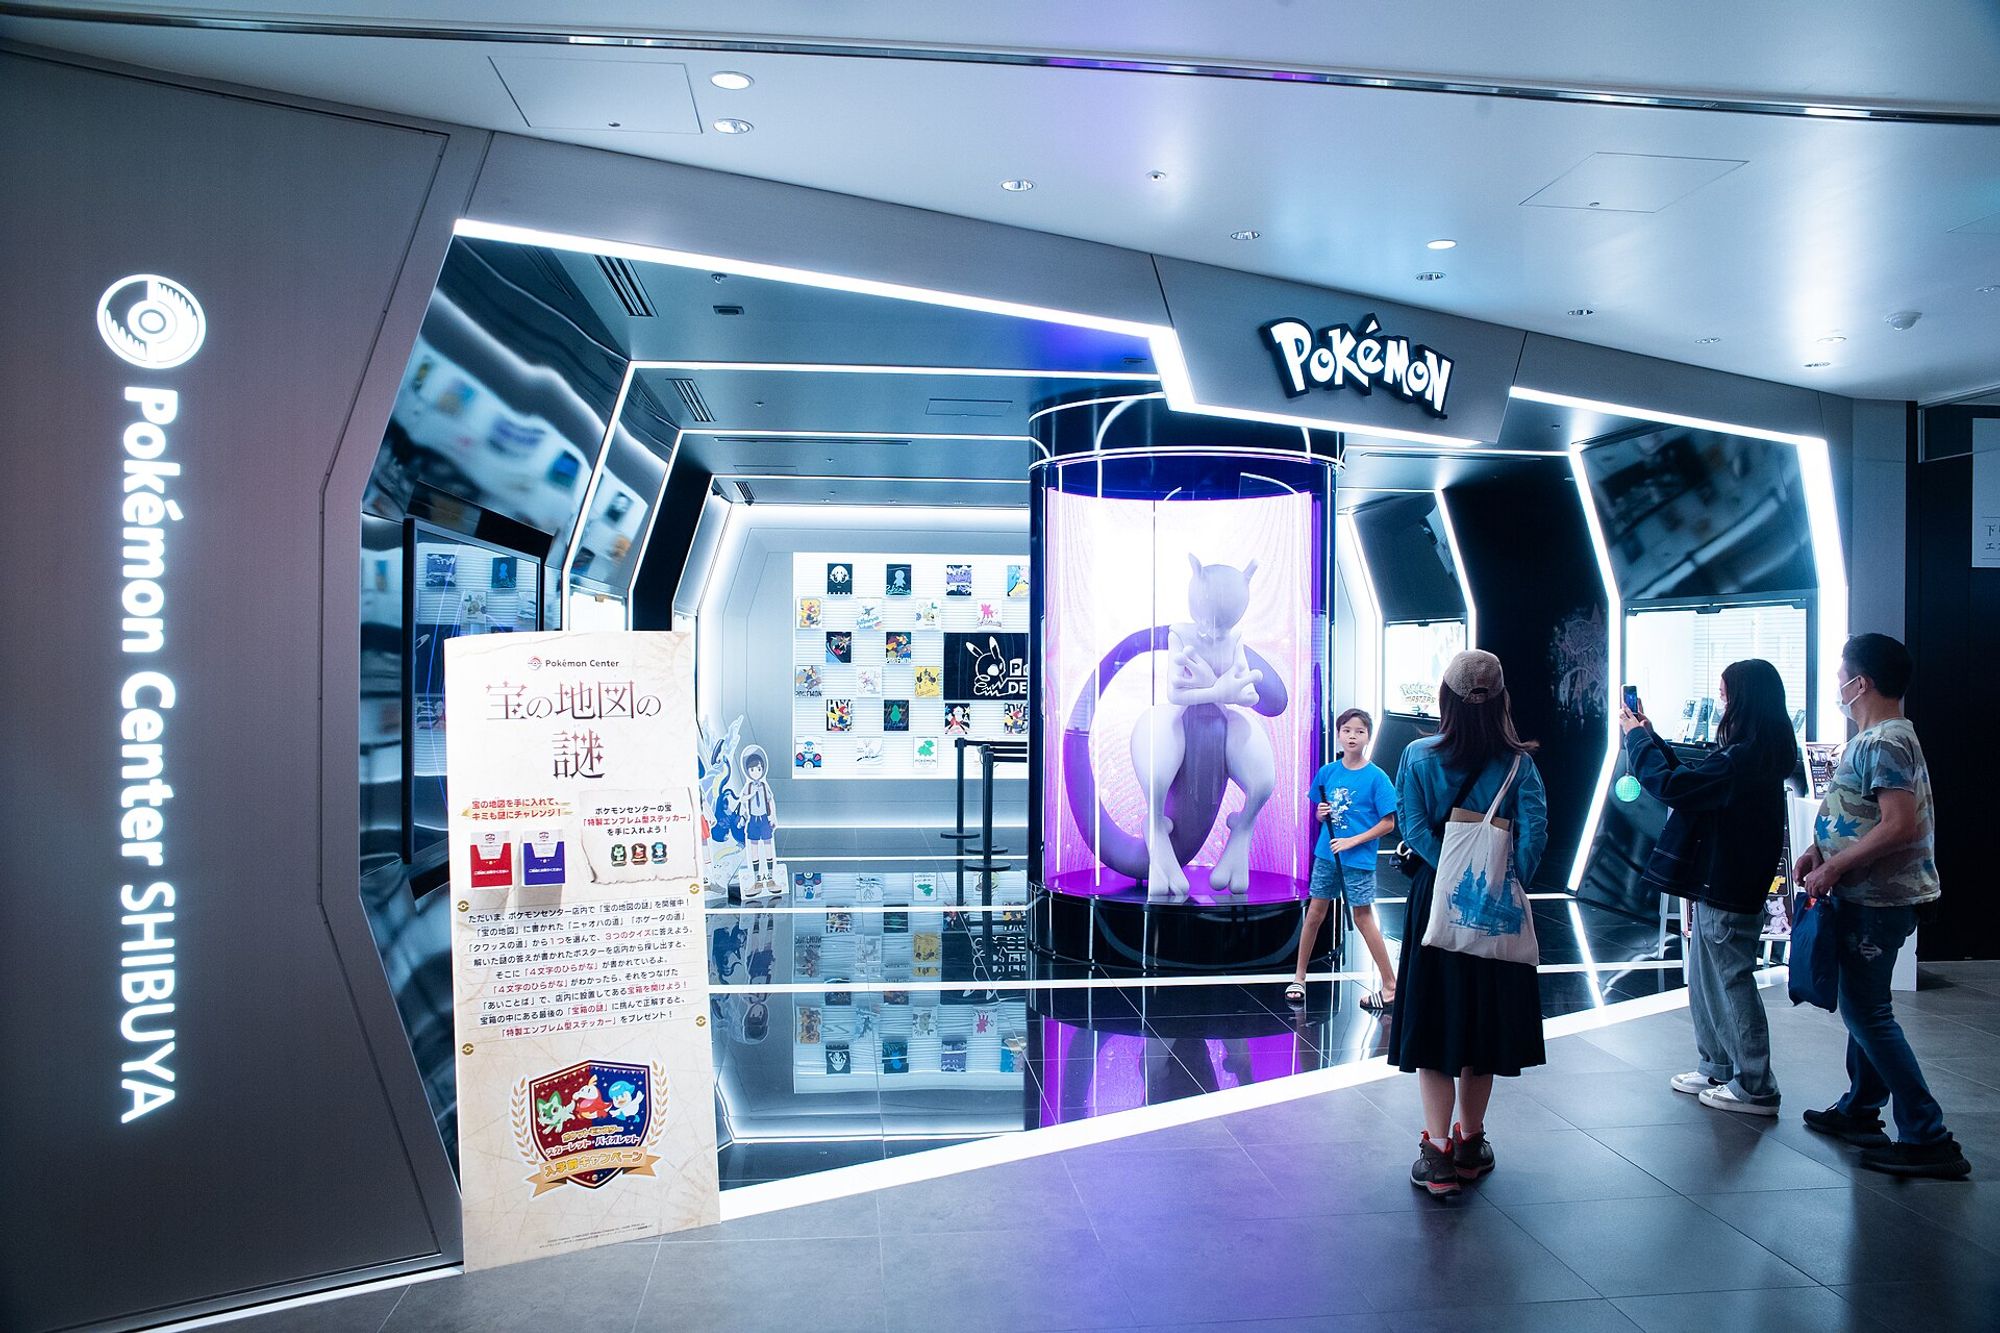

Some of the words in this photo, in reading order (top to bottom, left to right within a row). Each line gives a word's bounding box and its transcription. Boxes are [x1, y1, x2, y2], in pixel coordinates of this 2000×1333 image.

[121, 385, 184, 653] Pokémon
[1985, 524, 2000, 537] 下
[545, 658, 587, 667] Pokémon
[590, 659, 620, 667] Center
[485, 679, 662, 720] 宝の地図の
[120, 670, 176, 866] Center
[551, 727, 606, 779] 謎
[120, 880, 176, 1124] SHIBUYA
